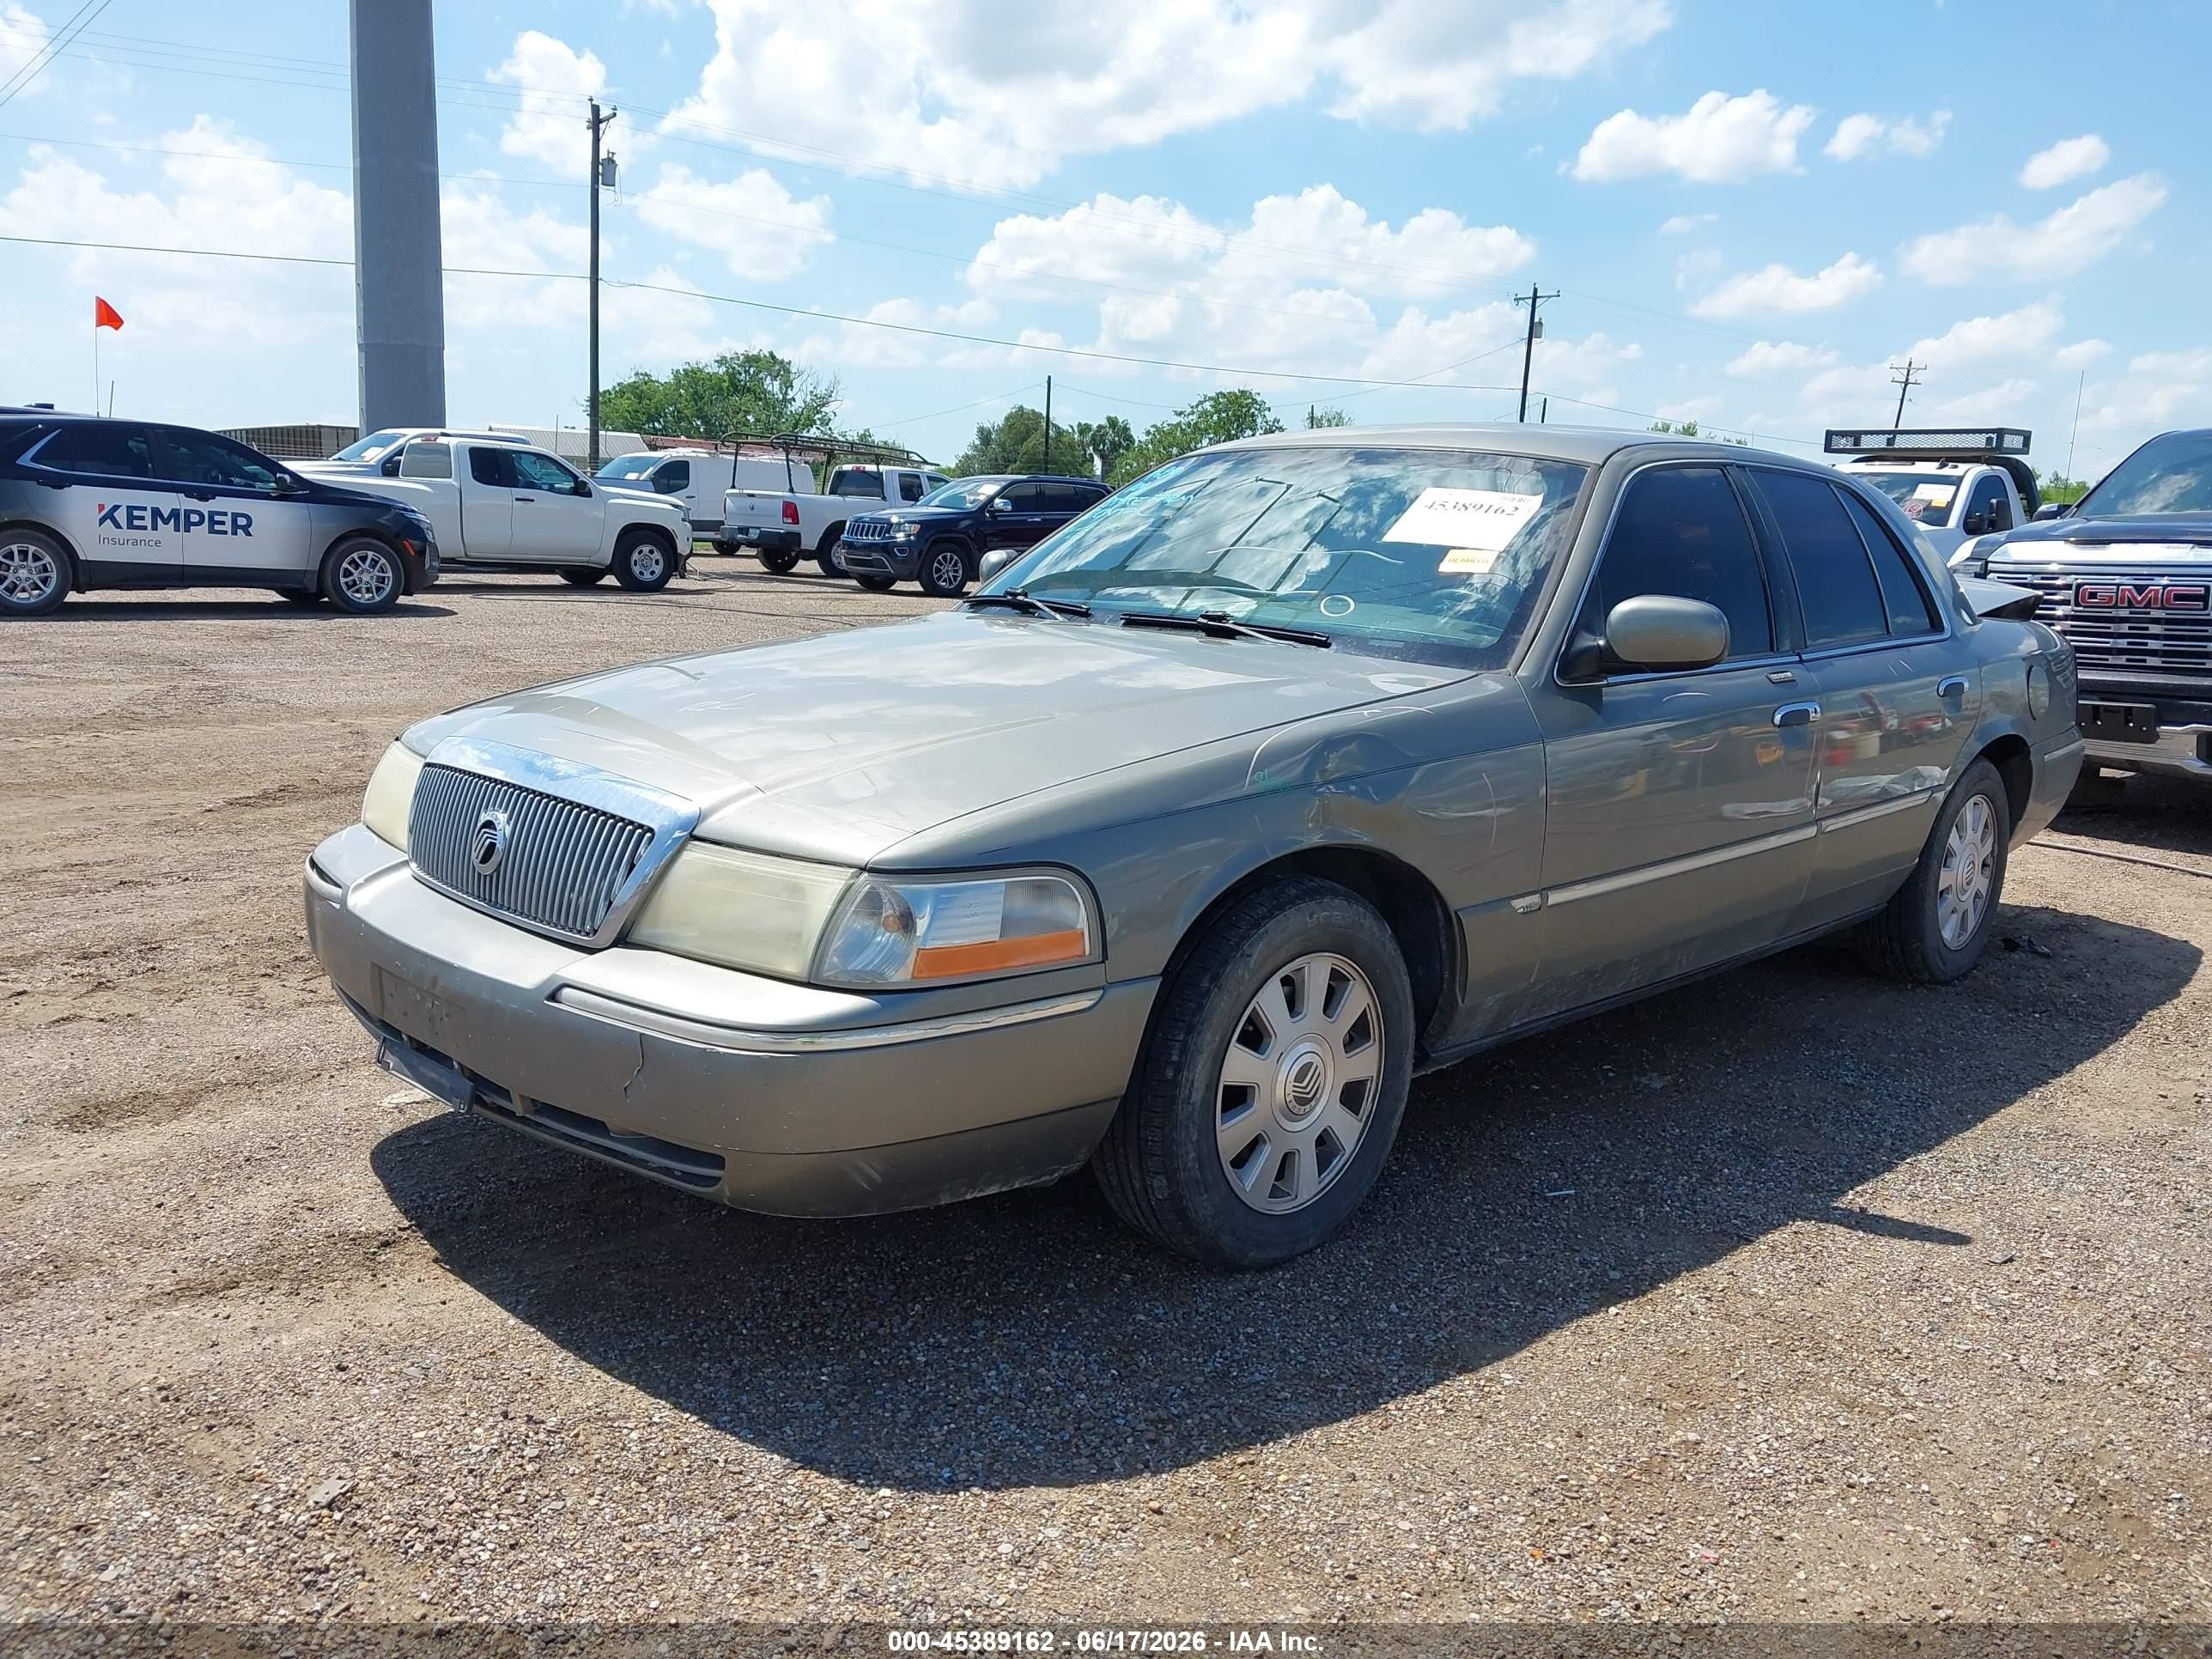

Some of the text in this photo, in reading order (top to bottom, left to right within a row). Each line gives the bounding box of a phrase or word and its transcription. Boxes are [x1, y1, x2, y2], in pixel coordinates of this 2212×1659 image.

[1424, 501, 1519, 516] 45389162
[97, 502, 254, 537] KEMPER
[98, 534, 162, 548] Insurance
[2079, 586, 2205, 609] GMC
